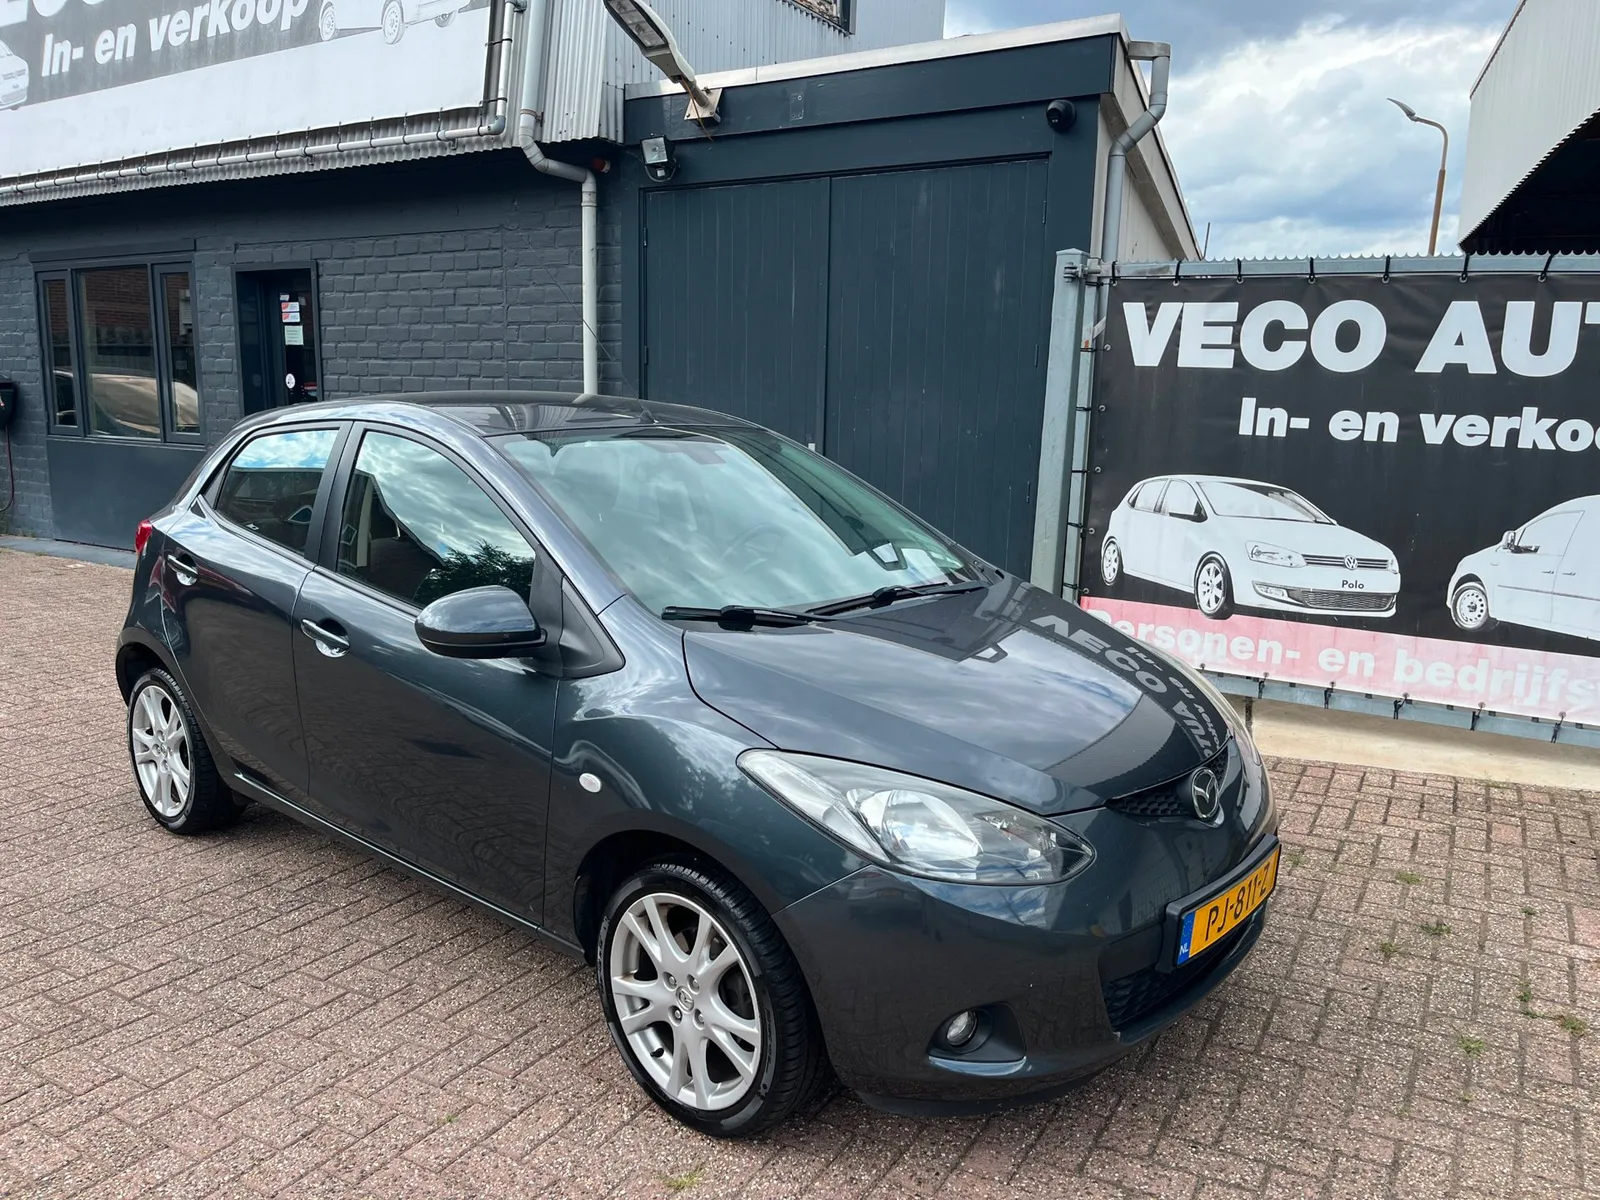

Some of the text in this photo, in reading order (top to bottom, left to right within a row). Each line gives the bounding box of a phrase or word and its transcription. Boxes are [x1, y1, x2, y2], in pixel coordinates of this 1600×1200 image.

[42, 33, 84, 77] In-
[94, 23, 137, 65] en
[148, 0, 308, 52] verkoop
[1122, 300, 1600, 377] VECO AU
[1238, 397, 1600, 452] In- en verko
[1341, 579, 1365, 589] Polo
[1318, 648, 1375, 678] en
[1394, 649, 1600, 707] bedrijfs
[1205, 861, 1271, 941] PJ-811-Z
[1179, 942, 1189, 955] NL
